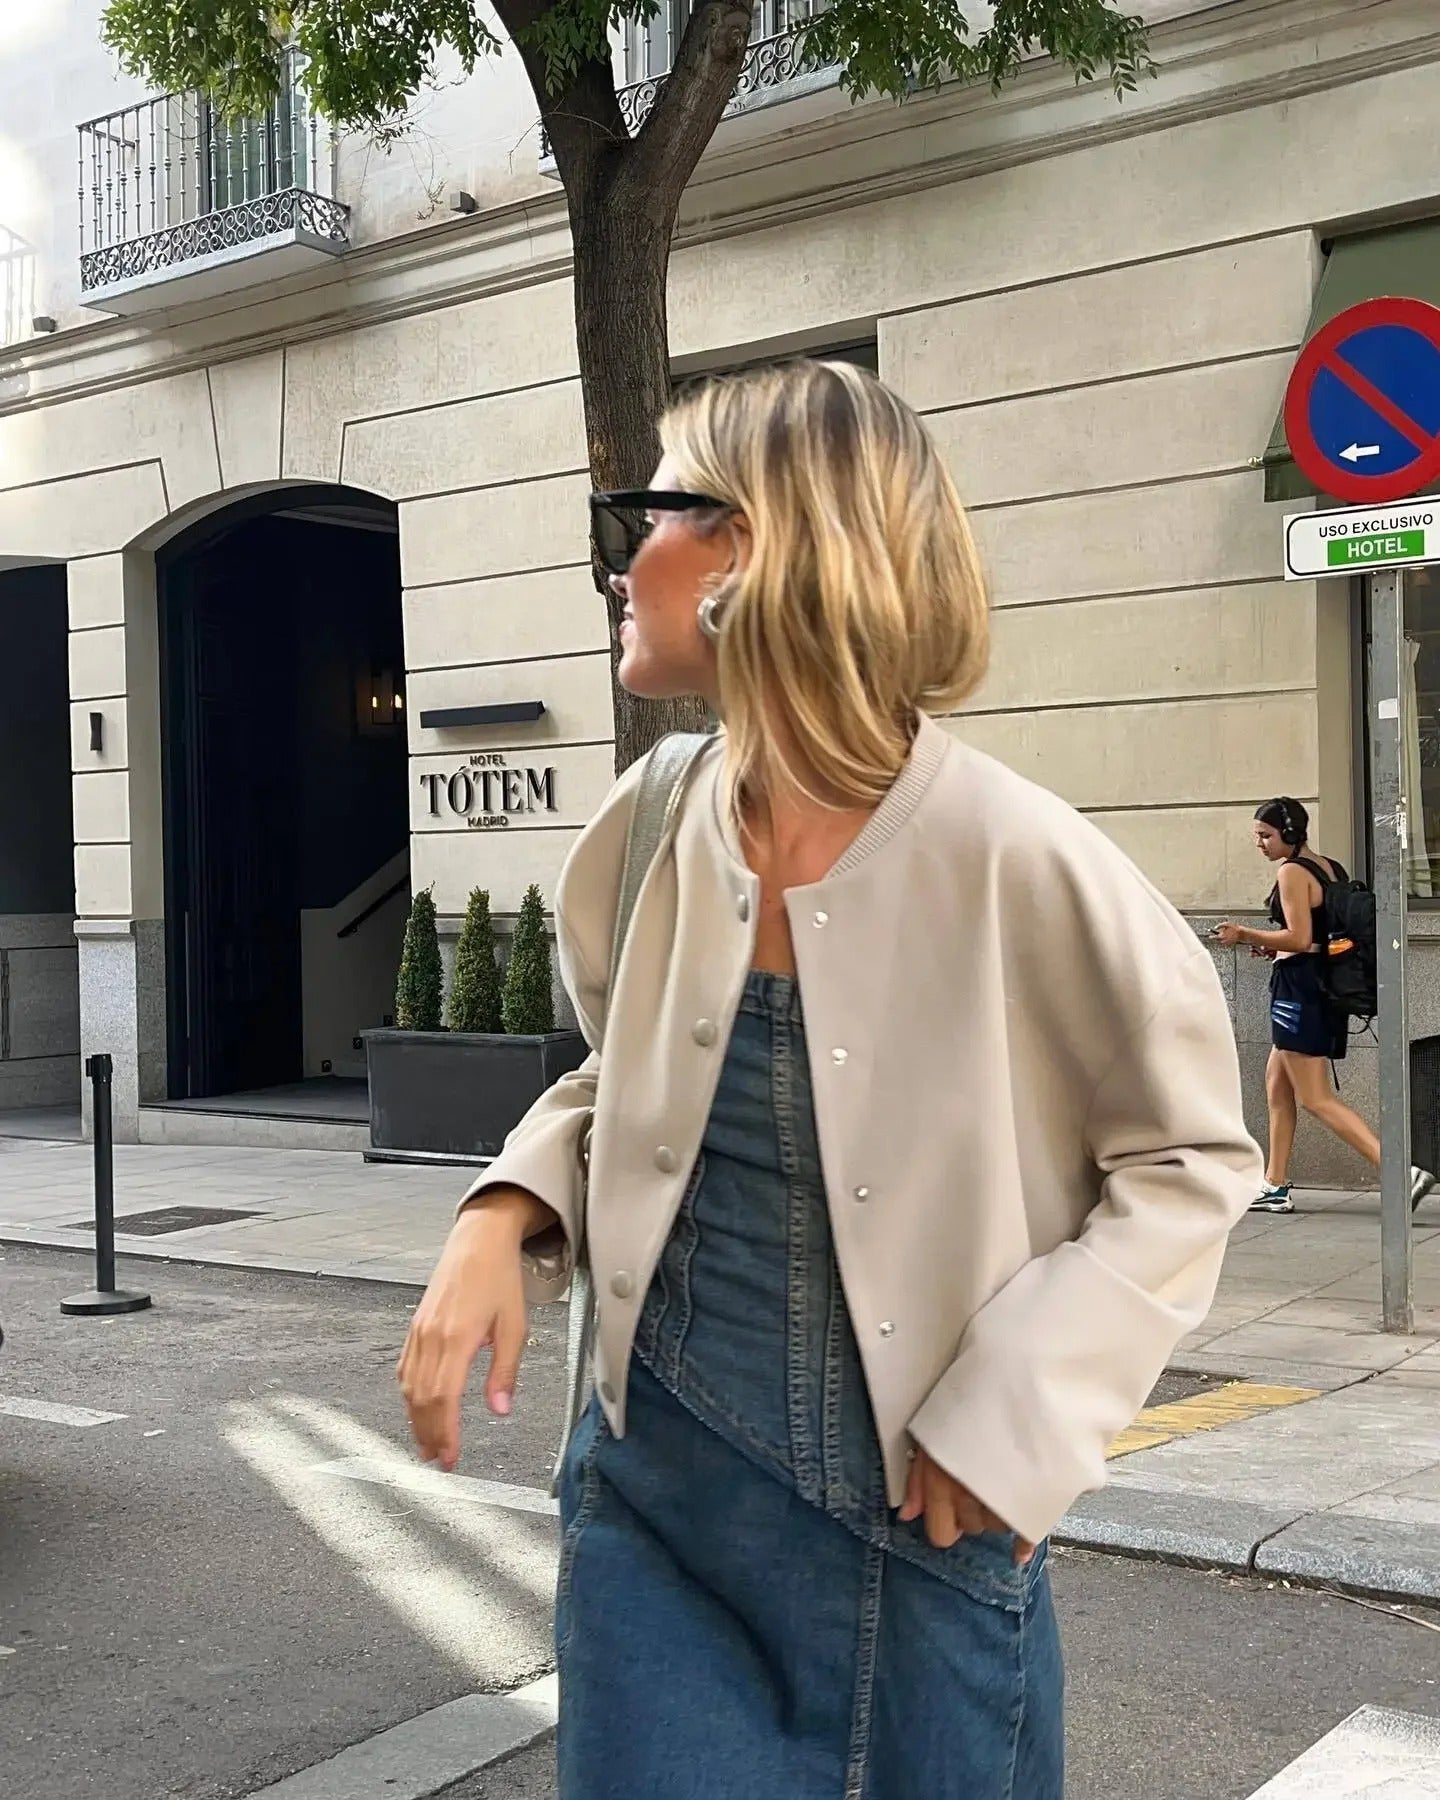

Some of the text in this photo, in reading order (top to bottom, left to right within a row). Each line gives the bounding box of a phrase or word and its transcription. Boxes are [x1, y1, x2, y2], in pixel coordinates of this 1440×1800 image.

[1319, 513, 1434, 538] USO EXCLUSIVO
[1347, 536, 1408, 558] HOTEL
[470, 754, 506, 766] HOTEL
[419, 766, 557, 815] TÓTEM
[467, 816, 509, 827] MADRID
